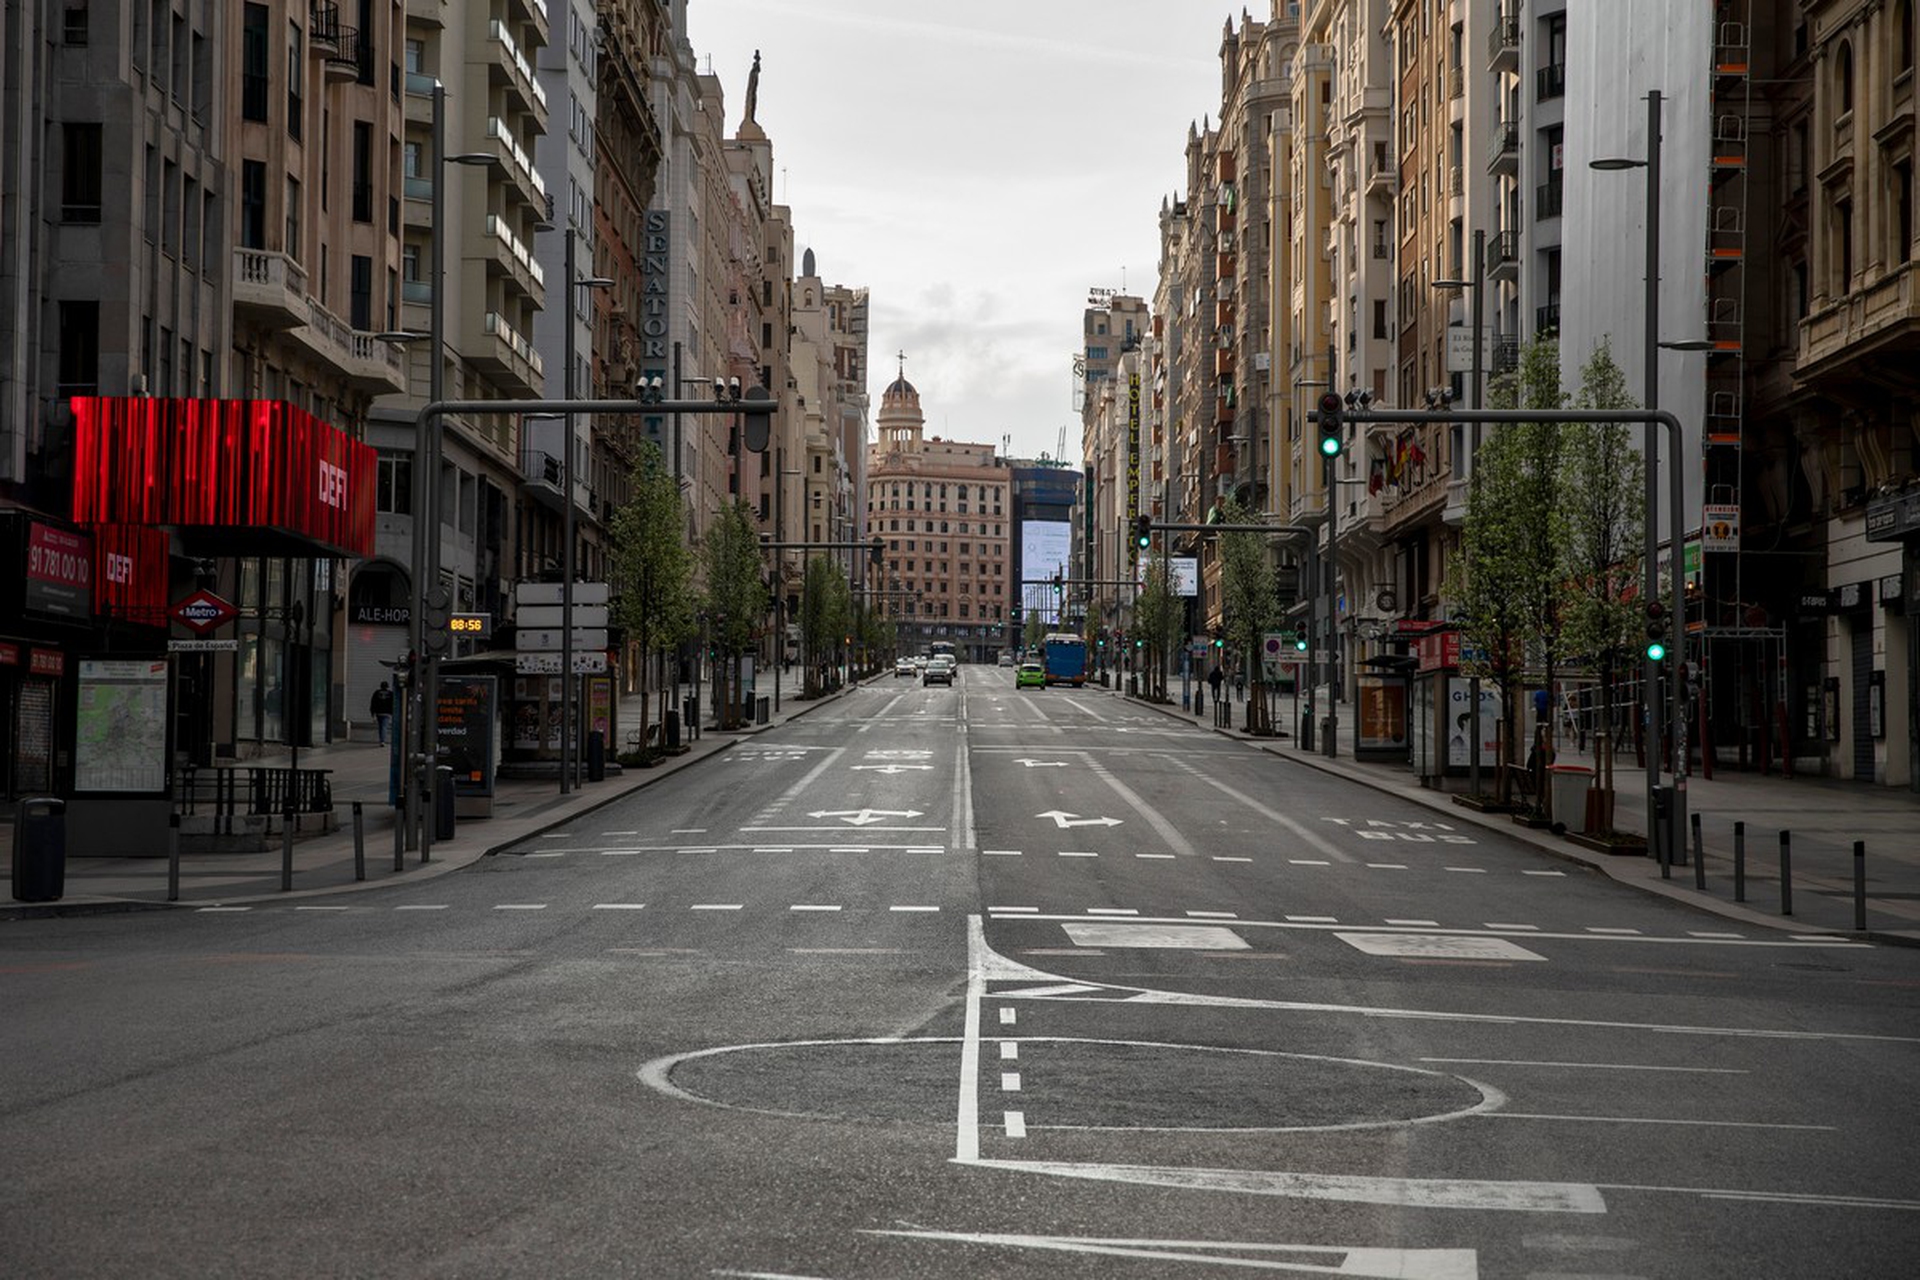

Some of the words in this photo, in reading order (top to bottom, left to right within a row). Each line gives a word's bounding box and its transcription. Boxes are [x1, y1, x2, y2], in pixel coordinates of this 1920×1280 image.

[644, 211, 667, 359] SENATOR
[1129, 373, 1140, 446] HOTEL
[32, 545, 42, 573] 91
[44, 548, 60, 577] 781
[62, 553, 76, 581] 00
[78, 556, 89, 584] 10
[185, 607, 217, 617] Metro
[358, 607, 410, 622] ALE-HOP
[172, 641, 193, 649] Plaza
[205, 641, 234, 650] España
[437, 727, 467, 736] verdad
[1320, 817, 1455, 831] TAXI
[1355, 830, 1478, 844] BUS
